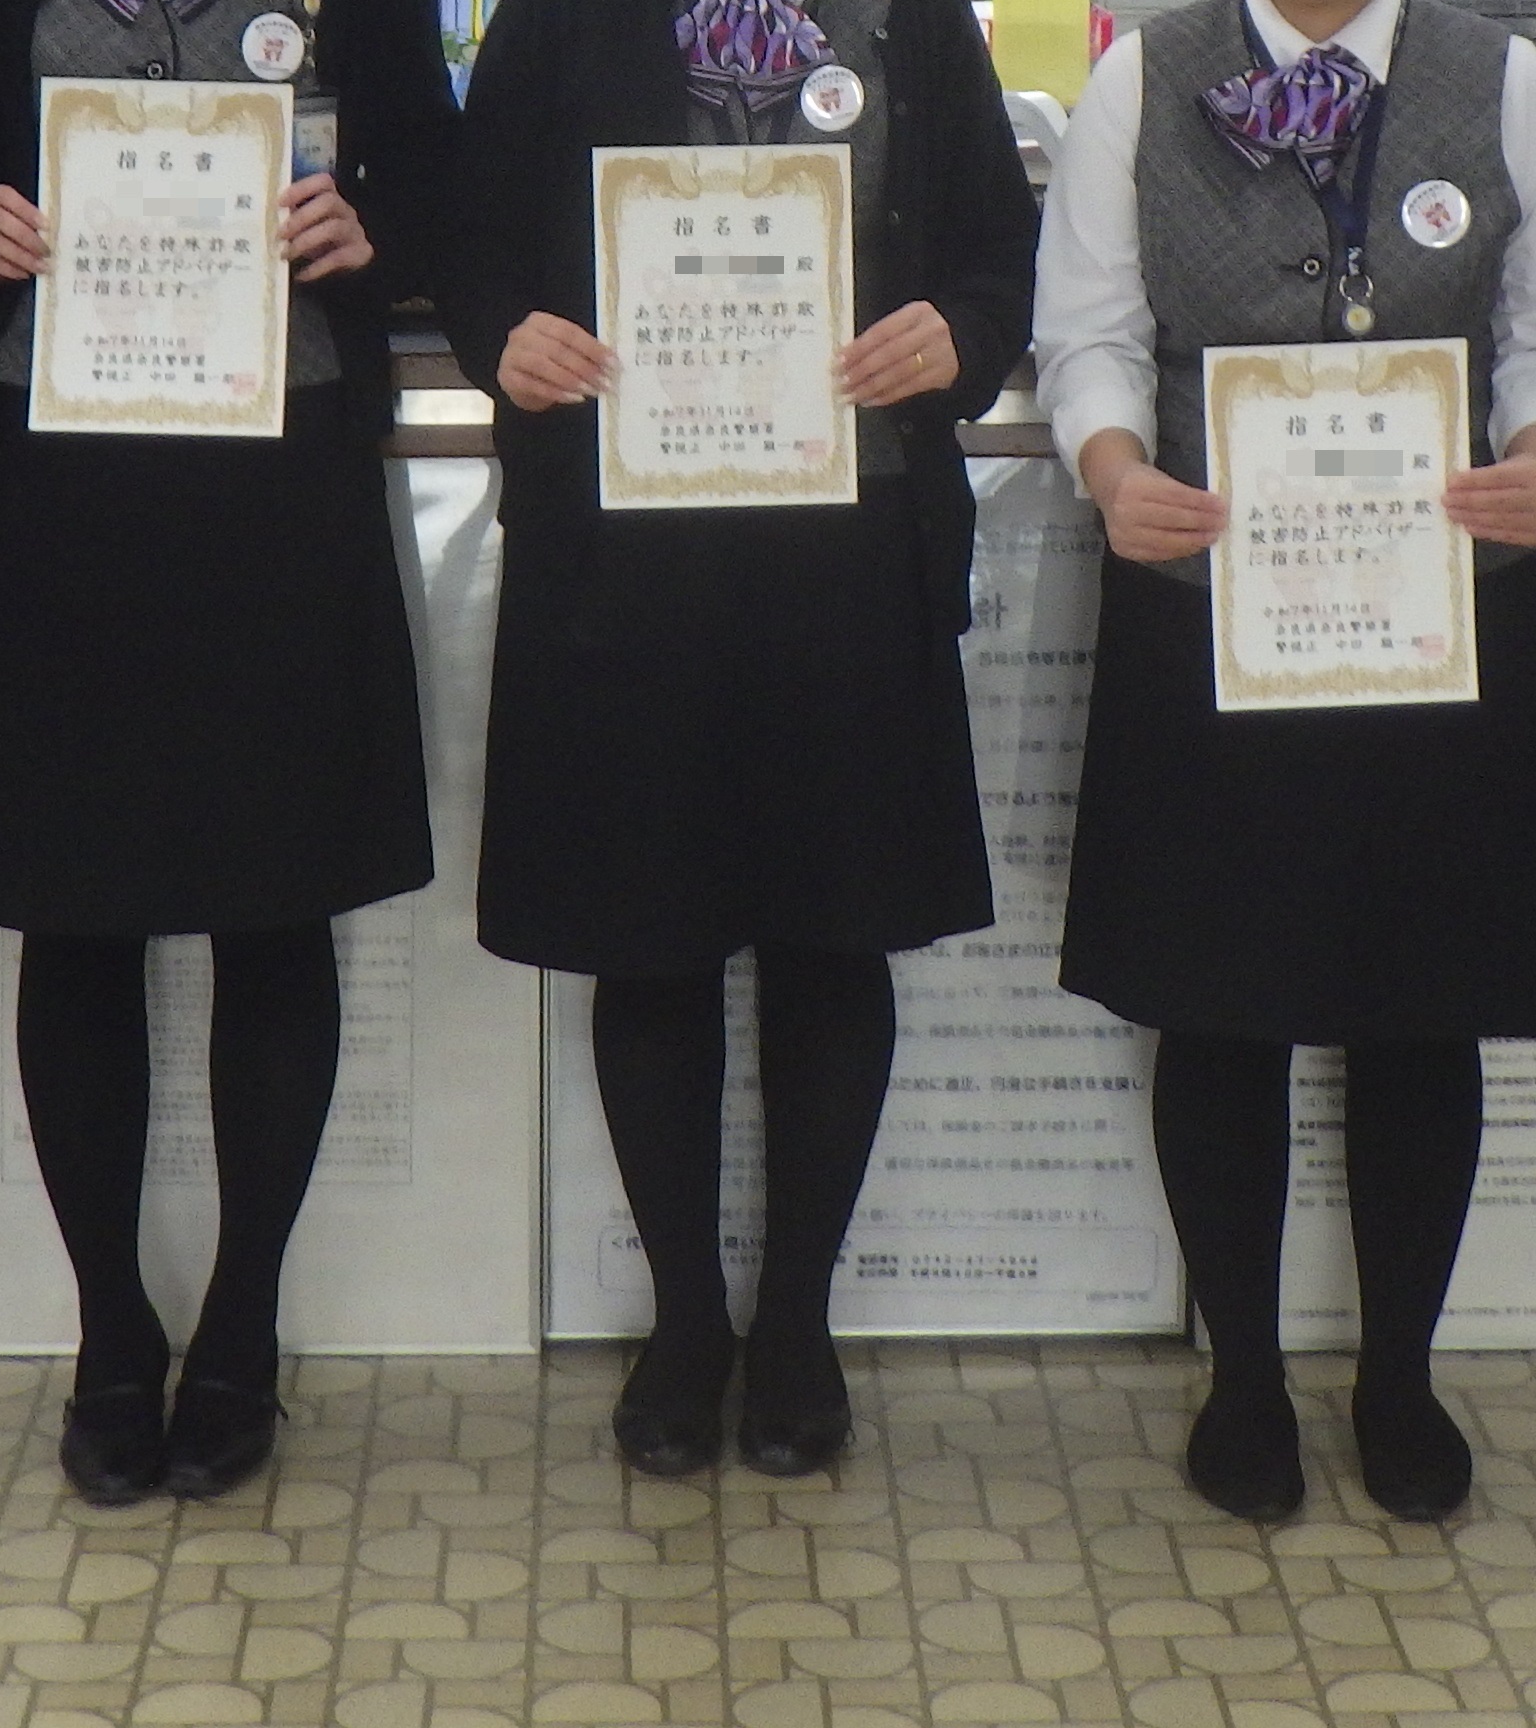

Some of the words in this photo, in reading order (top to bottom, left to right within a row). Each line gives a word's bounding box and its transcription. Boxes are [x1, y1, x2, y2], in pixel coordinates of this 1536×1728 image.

[116, 149, 214, 172] 指名書
[673, 213, 773, 237] 指名書
[74, 232, 251, 254] あなたを特殊詐欺
[75, 256, 251, 275] 被害防止アドバイザー
[72, 280, 200, 300] に指名します。
[634, 301, 815, 320] あなたを特殊詐欺
[635, 326, 815, 344] 被害防止アドバイザー
[634, 348, 764, 368] に指名します。
[1286, 411, 1388, 436] 指名書
[1248, 499, 1434, 522] あなたを特殊詐欺
[1249, 523, 1433, 545] 被害防止アドバイザー
[1248, 547, 1381, 567] に指名します。
